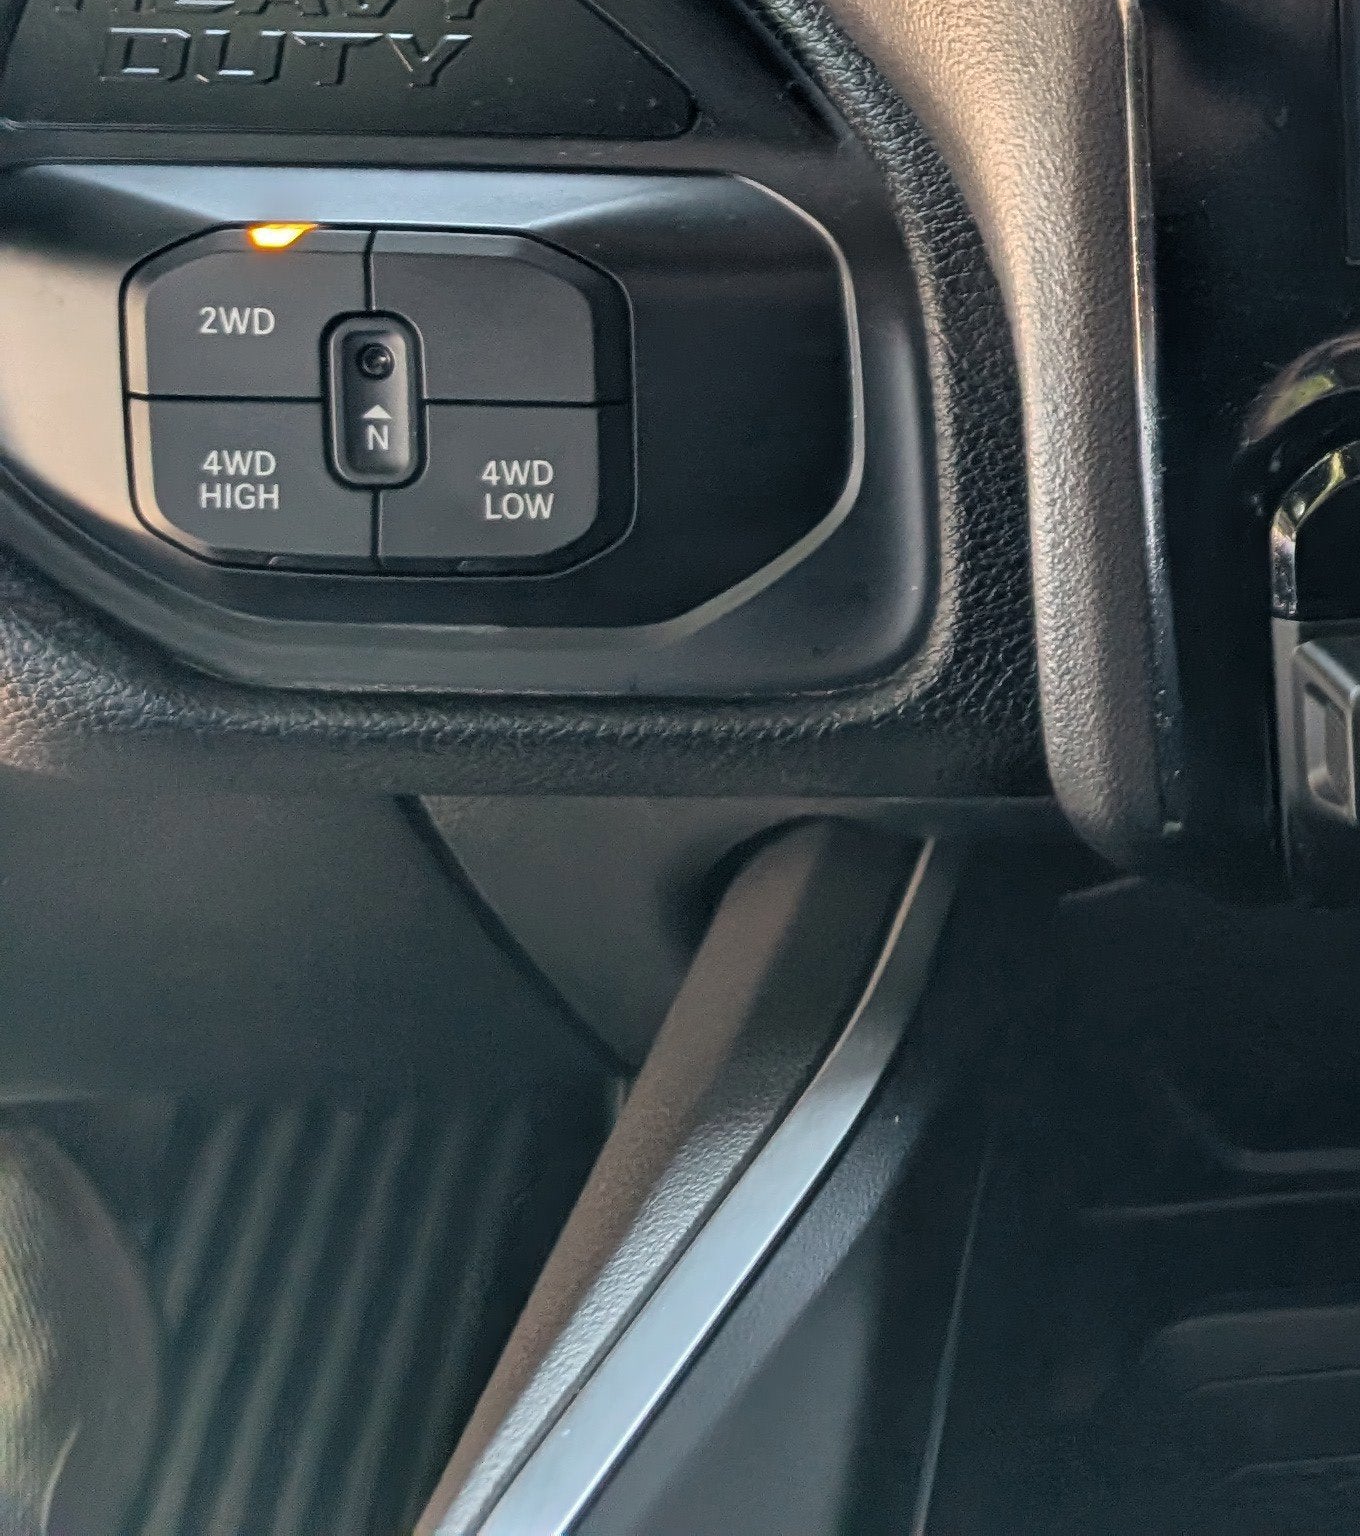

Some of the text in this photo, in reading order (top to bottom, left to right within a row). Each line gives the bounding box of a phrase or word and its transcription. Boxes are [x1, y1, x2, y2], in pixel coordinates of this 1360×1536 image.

[100, 27, 473, 87] DUTY
[200, 306, 276, 336] 2WD
[366, 424, 390, 452] N
[202, 449, 277, 477] 4WD
[481, 459, 555, 487] 4WD
[199, 482, 280, 511] HIGH
[484, 492, 555, 521] LOW
